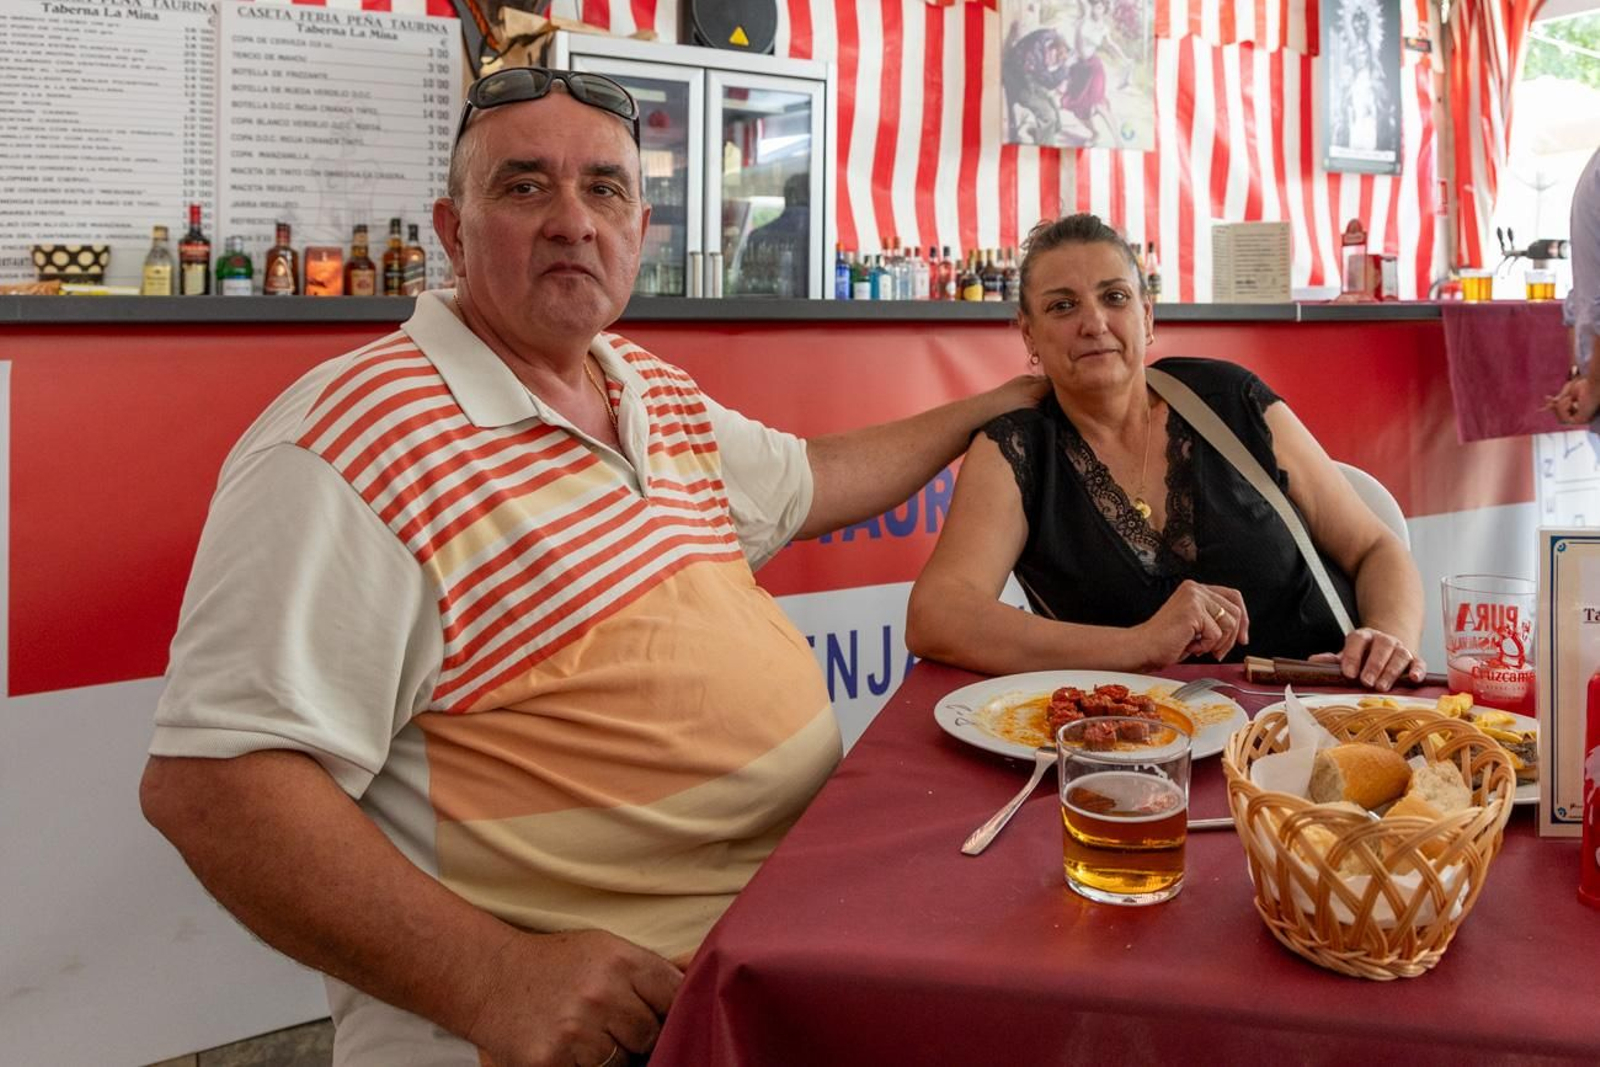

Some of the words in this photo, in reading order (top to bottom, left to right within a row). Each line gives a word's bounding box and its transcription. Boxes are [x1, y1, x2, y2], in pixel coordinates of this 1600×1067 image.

[42, 3, 99, 17] Taberna
[104, 8, 123, 19] La
[126, 9, 160, 22] Mina
[235, 6, 293, 22] CASETA
[298, 10, 341, 26] FERIA
[346, 12, 385, 30] PEÑA
[390, 18, 449, 36] TAURINA
[296, 23, 346, 38] Taberna
[349, 27, 367, 39] La
[369, 29, 399, 41] Mina
